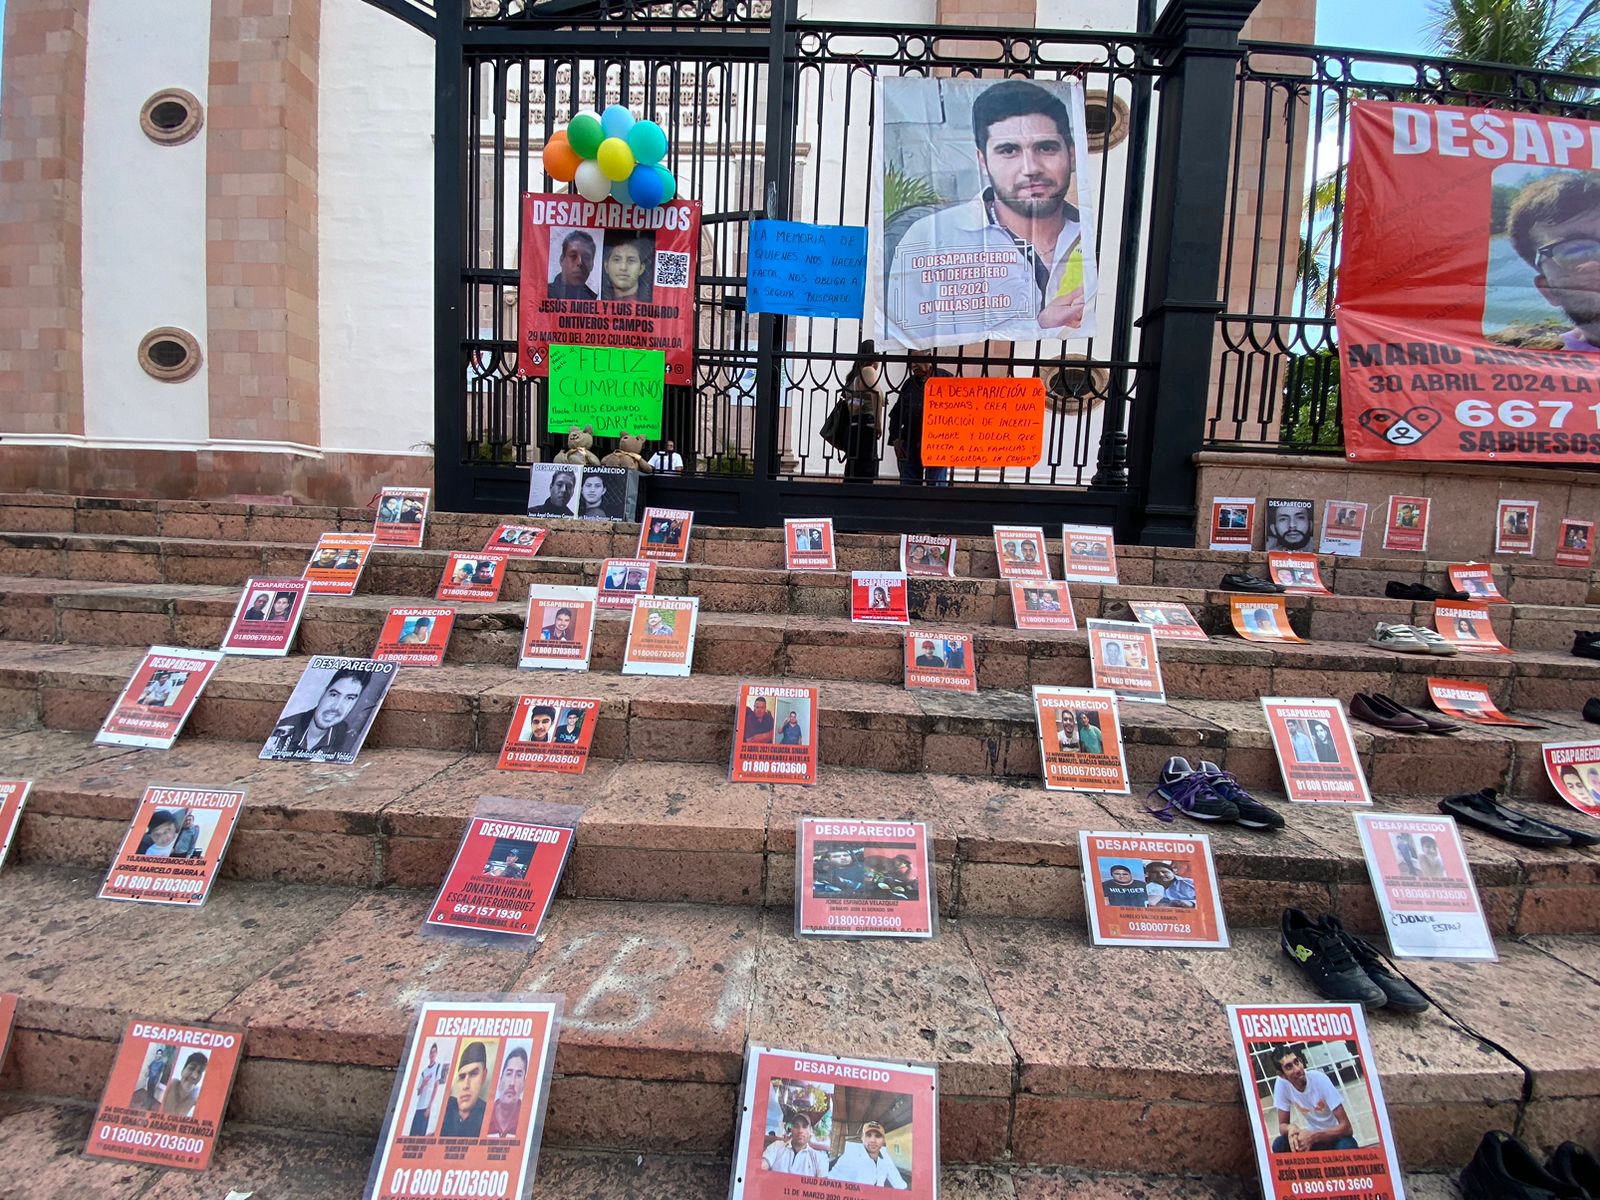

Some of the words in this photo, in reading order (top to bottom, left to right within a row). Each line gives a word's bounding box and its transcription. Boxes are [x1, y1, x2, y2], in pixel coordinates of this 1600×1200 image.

[533, 200, 690, 231] DESAPARECIDOS
[753, 230, 767, 241] LA
[776, 231, 826, 246] MEMORIA
[841, 235, 855, 246] DE
[754, 249, 799, 260] QUIENES
[805, 255, 823, 265] NOS
[912, 257, 924, 269] LO
[927, 251, 1017, 268] DESAPARECIERON
[788, 272, 807, 282] NOS
[814, 277, 846, 285] OBLIGA
[922, 271, 933, 283] EL
[947, 268, 961, 281] DE
[962, 266, 1008, 280] FEBRERO
[764, 287, 794, 298] SEGUIR
[940, 283, 958, 297] DEL
[961, 281, 989, 296] 2020
[570, 301, 599, 315] ANGEL
[602, 302, 609, 315] Y
[611, 303, 632, 316] LUIS
[635, 305, 679, 319] EDUARDO
[919, 302, 932, 315] EN
[934, 298, 970, 312] VILLAS
[971, 296, 990, 310] DEL
[558, 315, 609, 331] ONTIVEROS
[612, 317, 654, 333] CAMPOS
[528, 331, 538, 341] 29
[539, 331, 567, 343] MARZO
[569, 333, 583, 344] DEL
[585, 334, 605, 345] 2012
[607, 335, 648, 347] CULIACAN
[649, 337, 682, 349] SINALOA
[1348, 342, 1462, 368] MARIO
[1368, 374, 1403, 393] 30
[1411, 373, 1485, 392] ABRIL
[1491, 374, 1555, 393] 2024
[1561, 375, 1592, 393] LA
[929, 384, 942, 398] LA
[948, 383, 1026, 400] DESAPARICIÓN
[1032, 387, 1043, 396] DE
[574, 402, 597, 413] LUIS
[984, 402, 1007, 411] CREA
[1015, 402, 1036, 411] UNA
[1454, 399, 1573, 428] 667
[982, 417, 993, 426] DE
[979, 432, 1010, 440] DOLOR
[583, 466, 625, 475] DESAPARECIDO
[1269, 501, 1312, 509] DESAPARECIDO
[908, 534, 950, 546] DESAPARECIDO
[1272, 559, 1314, 568] DESAPARECIDO
[858, 578, 901, 587] DESAPARECIDA
[639, 601, 692, 610] DESAPARECIDO
[1436, 607, 1488, 620] DESAPARECIDA
[234, 633, 283, 642] 018006703600
[910, 631, 968, 642] DESAPARECIDO
[632, 649, 685, 658] 018006703600
[149, 657, 206, 672] DESAPARECIDO
[312, 659, 393, 673] DESAPARECIDO
[910, 675, 970, 686] 018006703600
[749, 686, 810, 698] DESAPARECIDO
[1432, 687, 1488, 702] DESAPARECIDA
[524, 698, 595, 709] DESAPARECIDO
[1042, 698, 1108, 710] DESAPARECIDO
[1276, 708, 1331, 718] DESAPARECIDO
[507, 752, 580, 764] 018006703600
[742, 761, 752, 772] 01
[753, 761, 770, 772] 800
[771, 762, 807, 774] 6703600
[1051, 764, 1118, 777] 018006703600
[1296, 781, 1306, 790] 01
[1307, 781, 1320, 791] 800
[1321, 781, 1354, 792] 6703600
[150, 790, 237, 808] DESAPARECIDO
[479, 822, 560, 844] DESAPARECIDO
[815, 825, 915, 837] DESAPARECIDO
[1371, 821, 1446, 832] DESAPARECIDO
[1095, 839, 1195, 854] DESAPARECIDO
[115, 864, 138, 872] JORGE
[139, 866, 172, 875] MARCELO
[172, 868, 198, 876] IBARRA
[114, 875, 129, 888] 01
[129, 876, 152, 890] 800
[153, 878, 203, 893] 6703600
[461, 882, 501, 897] JONATAN
[501, 886, 533, 900] HIRAIN
[1392, 888, 1467, 900] 018006703600
[446, 892, 492, 907] ESCALANTE
[492, 898, 536, 912] RODRIGUEZ
[454, 904, 475, 914] 667
[476, 905, 496, 916] 157
[496, 909, 522, 920] 1930
[828, 915, 902, 927] 018006703600
[1129, 921, 1191, 933] 01800077628
[435, 1017, 533, 1036] DESAPARECIDO
[1241, 1013, 1353, 1038] DESAPARECIDO
[133, 1024, 235, 1048] DESAPARECIDO
[794, 1060, 890, 1083] DESAPARECIDO
[178, 1123, 214, 1137] RETAMOZA
[100, 1125, 204, 1153] 018006703600
[390, 1168, 411, 1194] 01
[410, 1169, 442, 1196] 800
[442, 1169, 509, 1197] 6703600
[819, 1180, 842, 1189] ZAPATA
[844, 1183, 860, 1191] SOSA
[1292, 1182, 1303, 1194] 01
[1304, 1180, 1325, 1194] 800
[1325, 1179, 1346, 1192] 670
[1348, 1177, 1373, 1190] 3600
[791, 1188, 800, 1197] DE
[802, 1191, 825, 1200] MARZO
